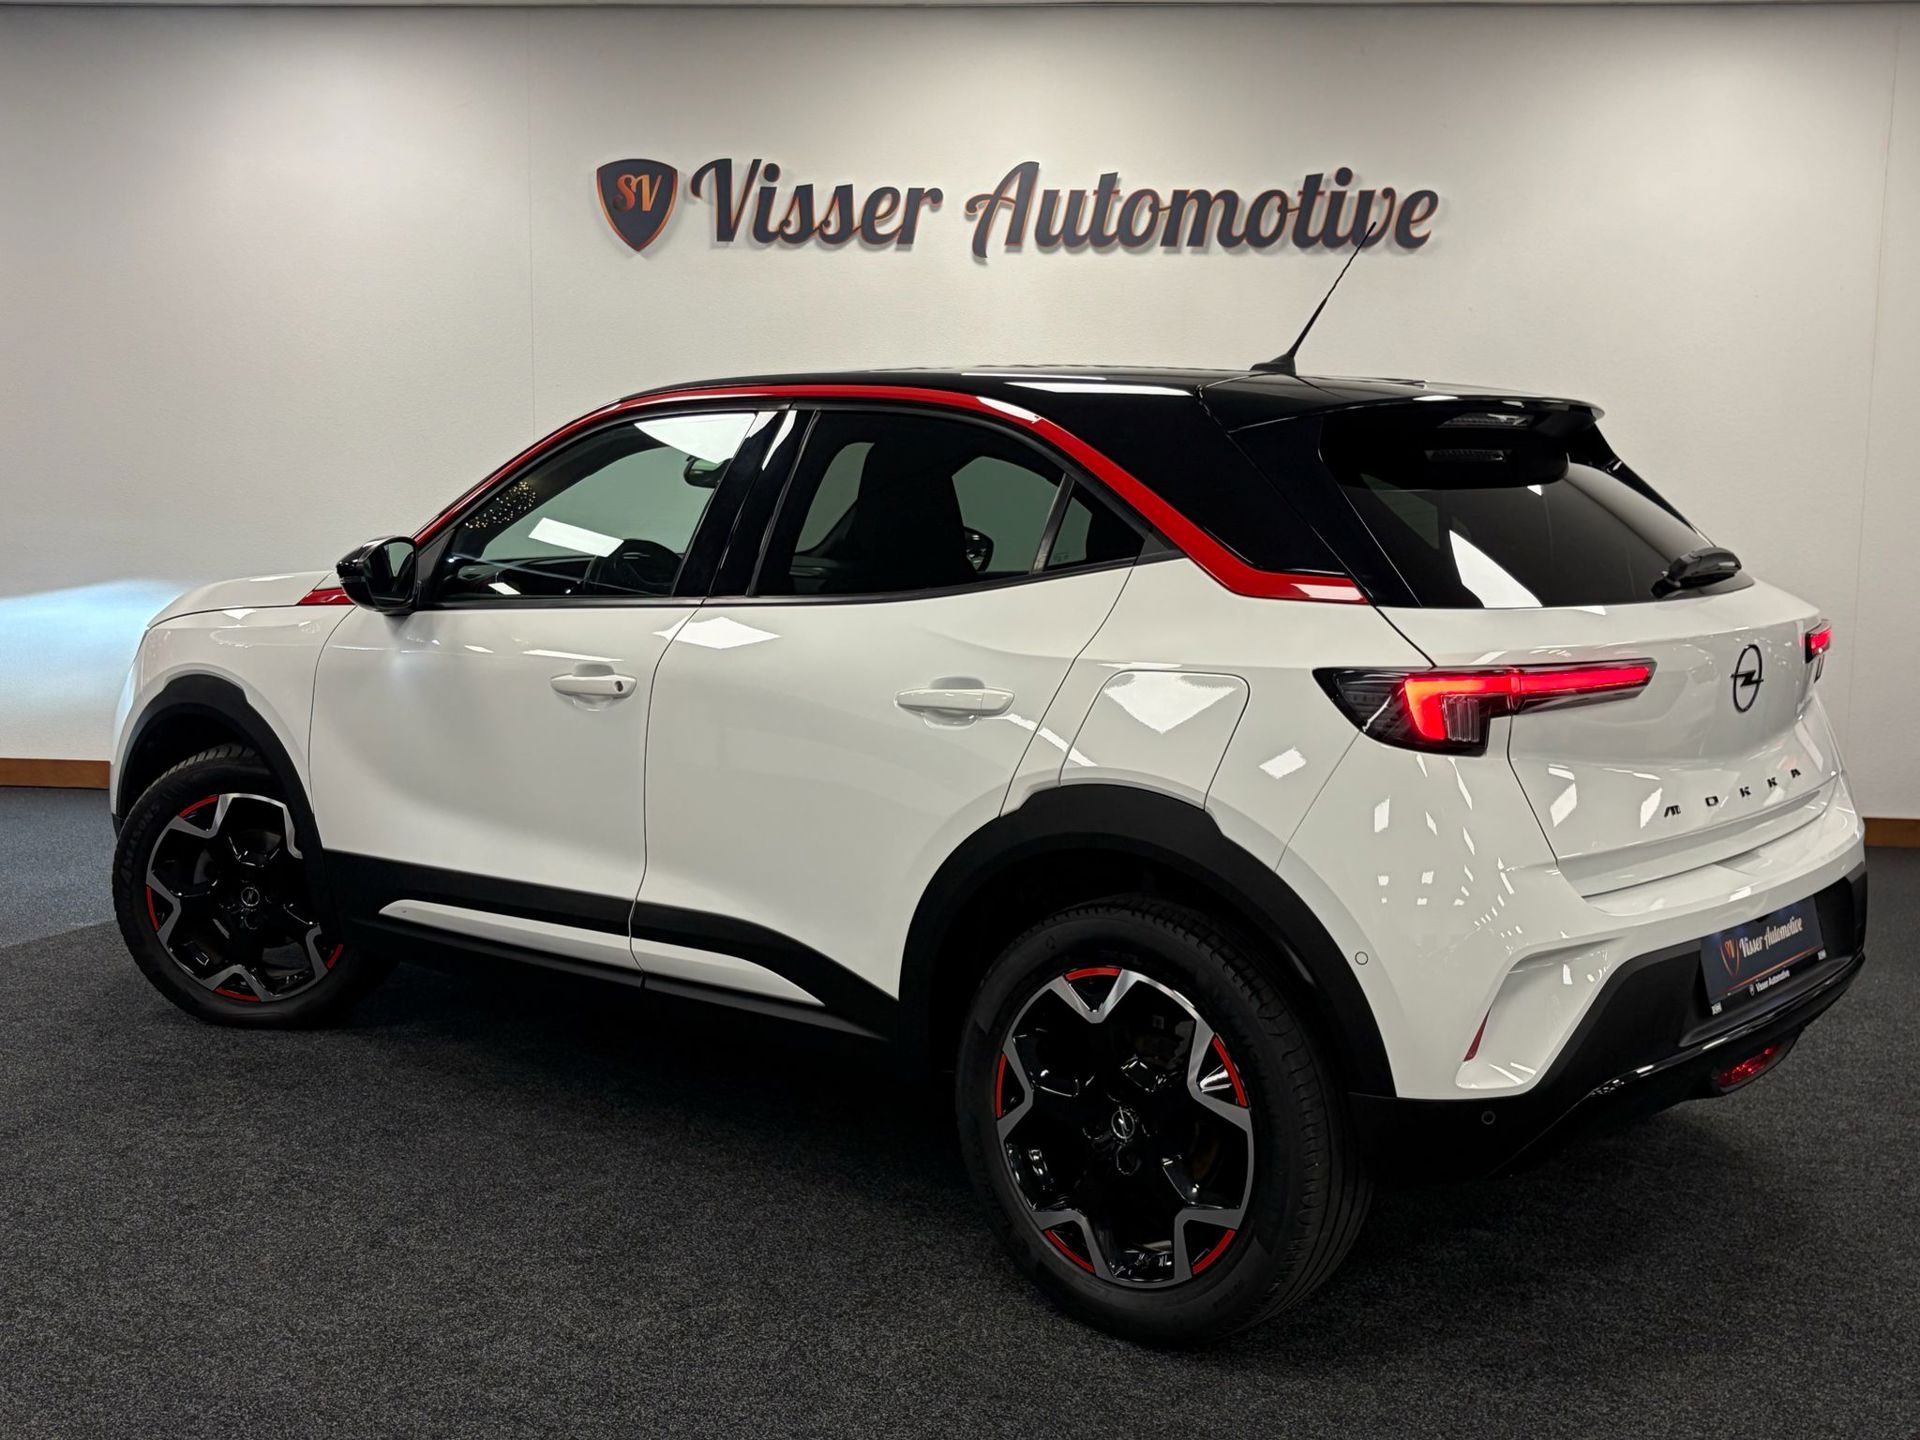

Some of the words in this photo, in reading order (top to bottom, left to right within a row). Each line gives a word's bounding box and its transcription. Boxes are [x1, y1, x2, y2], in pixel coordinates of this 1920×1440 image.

[612, 174, 662, 213] SV
[690, 158, 944, 245] Visser
[965, 161, 1439, 259] Automotive
[1663, 768, 1802, 818] MOKKA
[1739, 936, 1764, 958] Visser
[1764, 915, 1803, 950] Automotive
